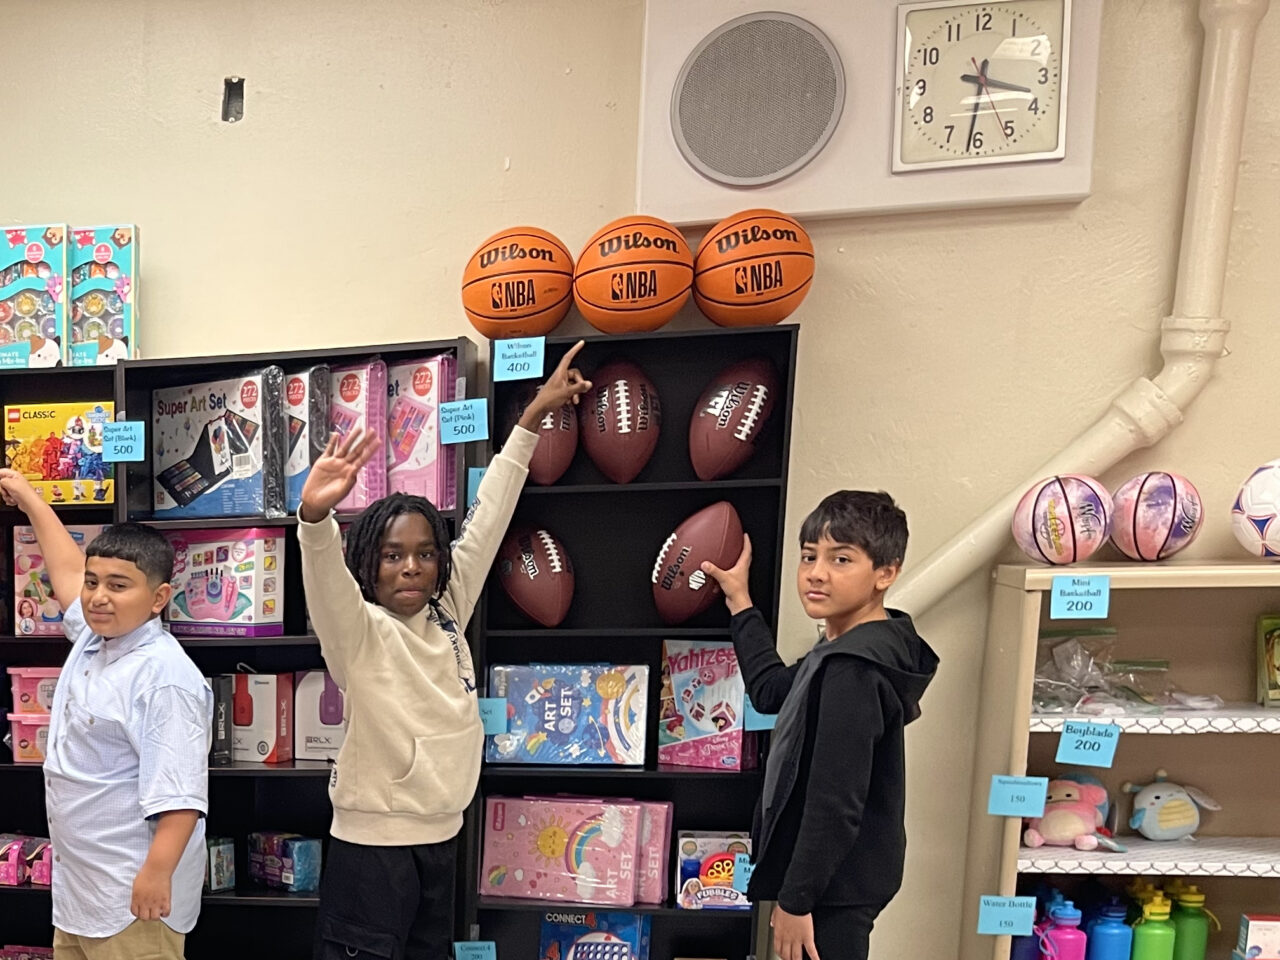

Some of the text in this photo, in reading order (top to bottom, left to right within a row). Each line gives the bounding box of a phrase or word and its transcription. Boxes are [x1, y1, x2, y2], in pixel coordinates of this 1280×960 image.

[976, 13, 992, 31] 12
[1012, 18, 1017, 37] 1
[948, 24, 960, 42] 11
[923, 47, 939, 65] 10
[1030, 39, 1041, 56] 2
[1038, 67, 1049, 85] 3
[915, 79, 926, 96] 9
[923, 106, 934, 123] 8
[1028, 97, 1039, 115] 4
[944, 125, 955, 143] 7
[1004, 120, 1015, 137] 5
[972, 132, 983, 149] 6
[598, 232, 680, 258] Wilson
[715, 226, 800, 254] Wilson
[479, 243, 556, 269] Wilson
[626, 270, 657, 300] NBA
[750, 261, 783, 293] NBA
[505, 279, 536, 308] NBA
[506, 362, 530, 373] 400
[342, 379, 360, 392] 272
[414, 371, 431, 384] 272
[242, 386, 258, 397] 272
[288, 383, 304, 395] 272
[387, 380, 400, 397] et
[157, 393, 227, 418] Super Art Set
[440, 406, 460, 414] Super
[453, 424, 475, 435] 500
[113, 445, 133, 454] 500
[661, 545, 692, 591] Wilson
[1072, 579, 1090, 587] Mini
[1060, 589, 1101, 597] Basketball
[1066, 601, 1093, 611] 200
[668, 648, 738, 675] Yahtzee
[560, 687, 573, 716] SET
[544, 701, 557, 731] ART
[1065, 724, 1114, 738] Beyblade
[1074, 740, 1101, 752] 200
[1011, 795, 1025, 803] 150
[621, 852, 633, 880] SET
[696, 888, 739, 900] FUBBLES
[983, 899, 1033, 909] Water Bottle
[546, 911, 597, 928] CONNECT 4
[999, 920, 1014, 928] 150
